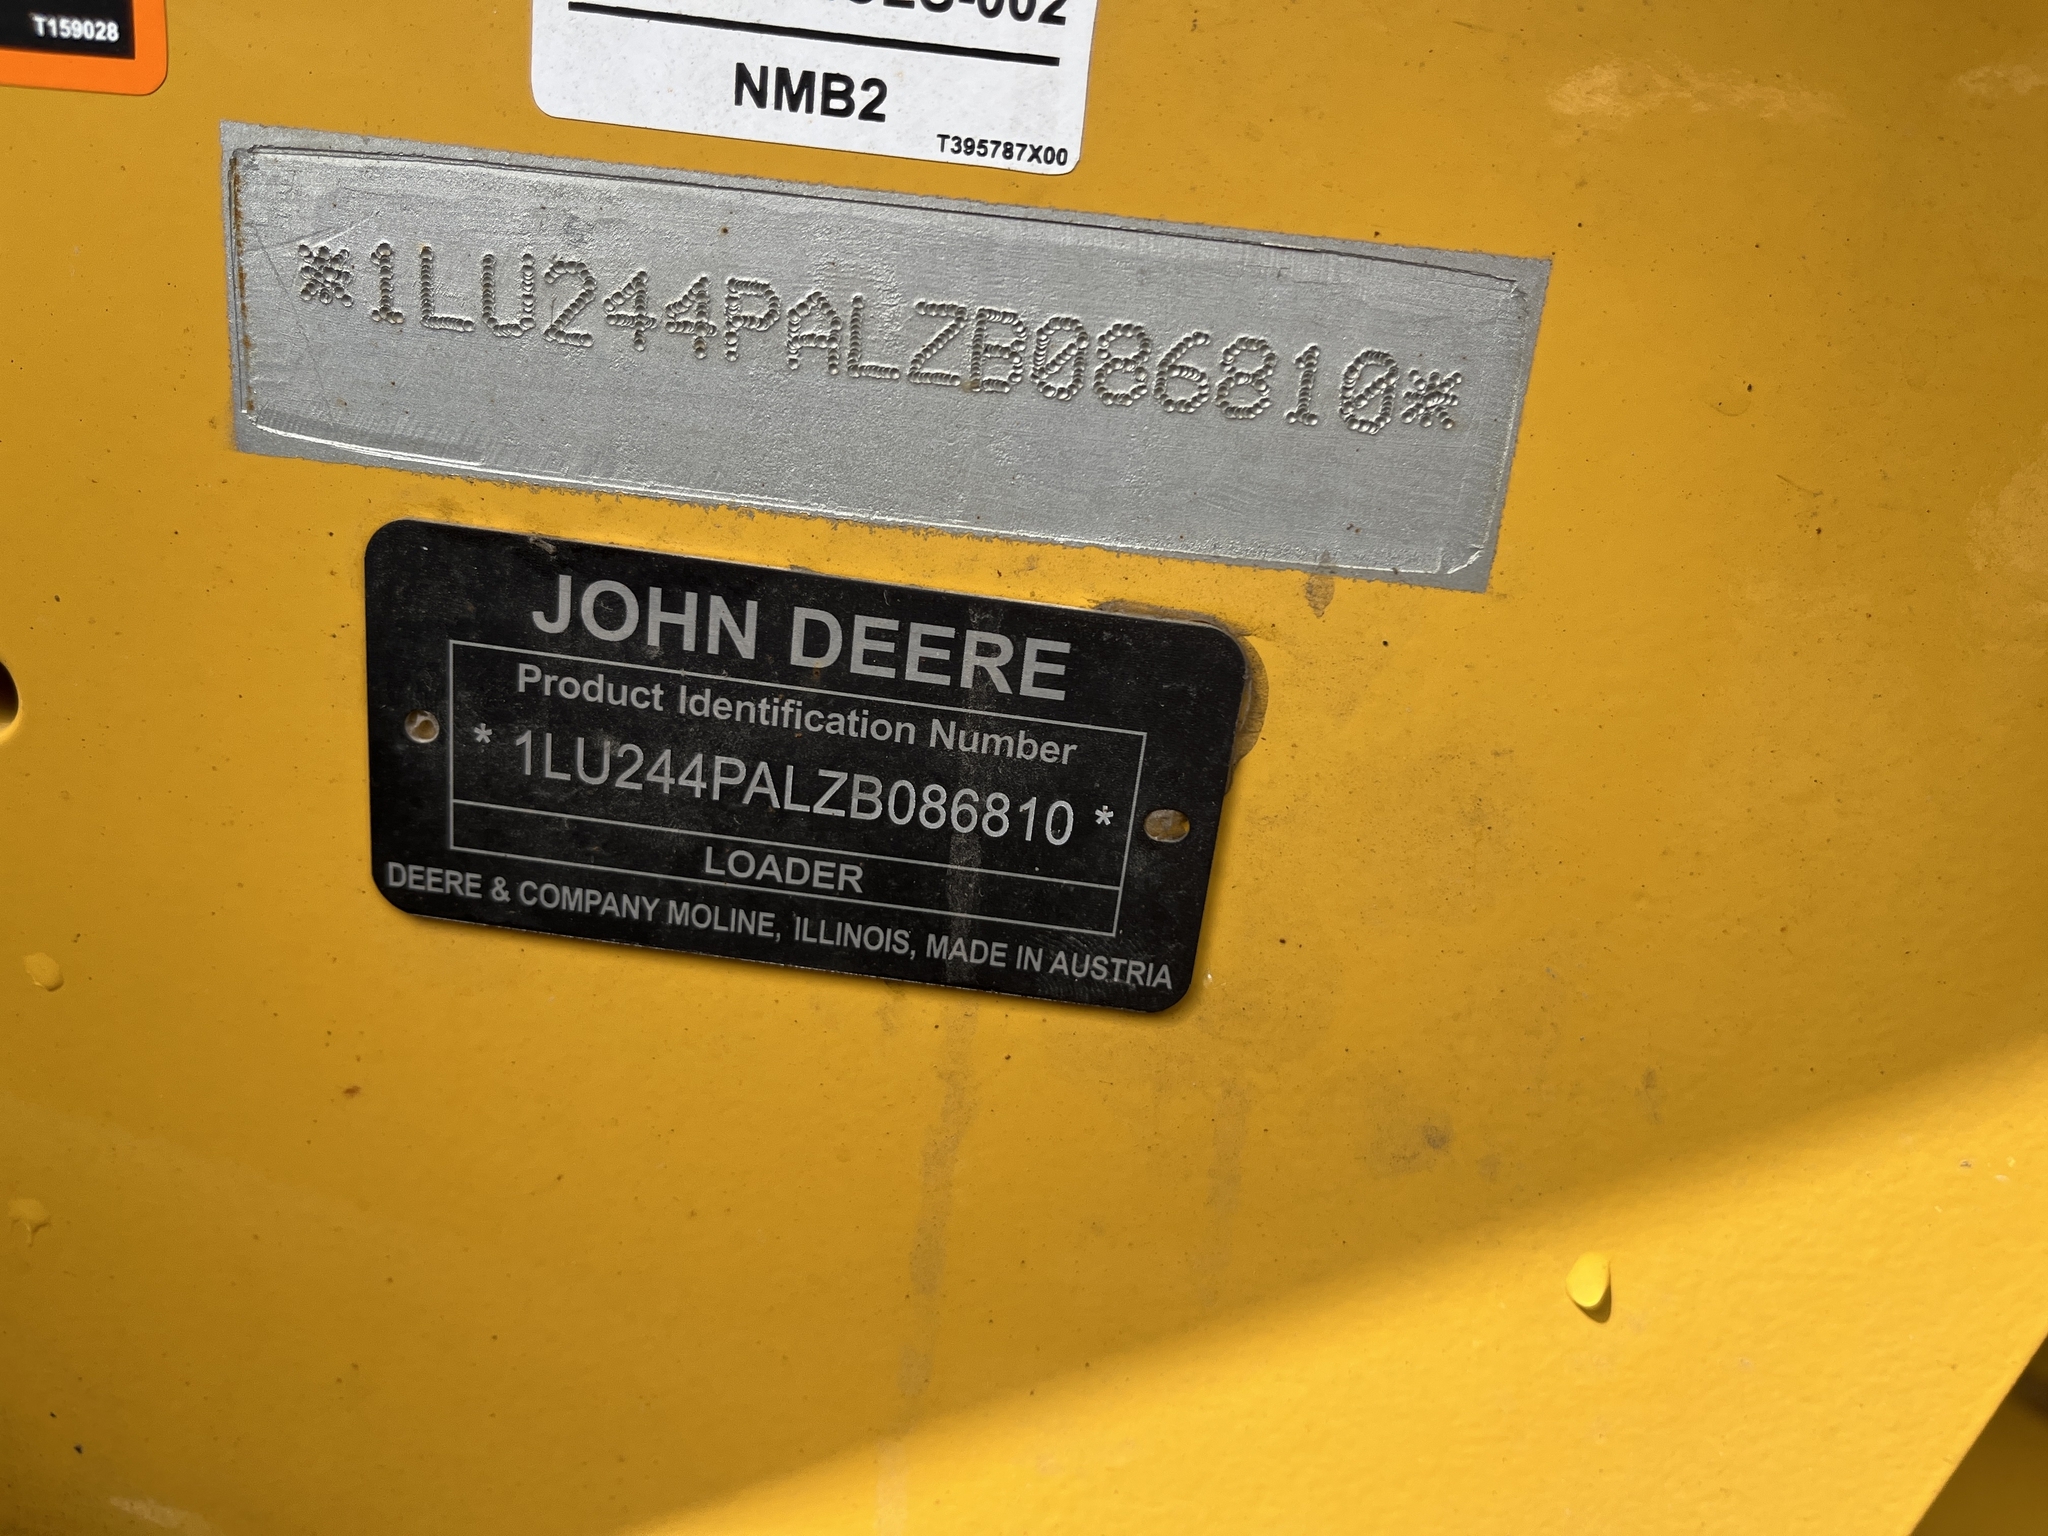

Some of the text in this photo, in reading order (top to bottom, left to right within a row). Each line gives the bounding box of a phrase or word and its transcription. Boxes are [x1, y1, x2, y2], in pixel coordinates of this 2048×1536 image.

[33, 15, 119, 42] T159028
[734, 62, 888, 123] NMB2
[937, 133, 1069, 168] T395787X00
[531, 574, 1072, 702] JOHN DEERE
[518, 662, 1078, 766] Product Identification Number
[514, 729, 1075, 847] 1LU244PALZB086810
[704, 845, 864, 893] LOADER
[387, 861, 1173, 990] DEERE & COMPANY MOLINE, ILLINOIS, MADE IN AUSTRIA
